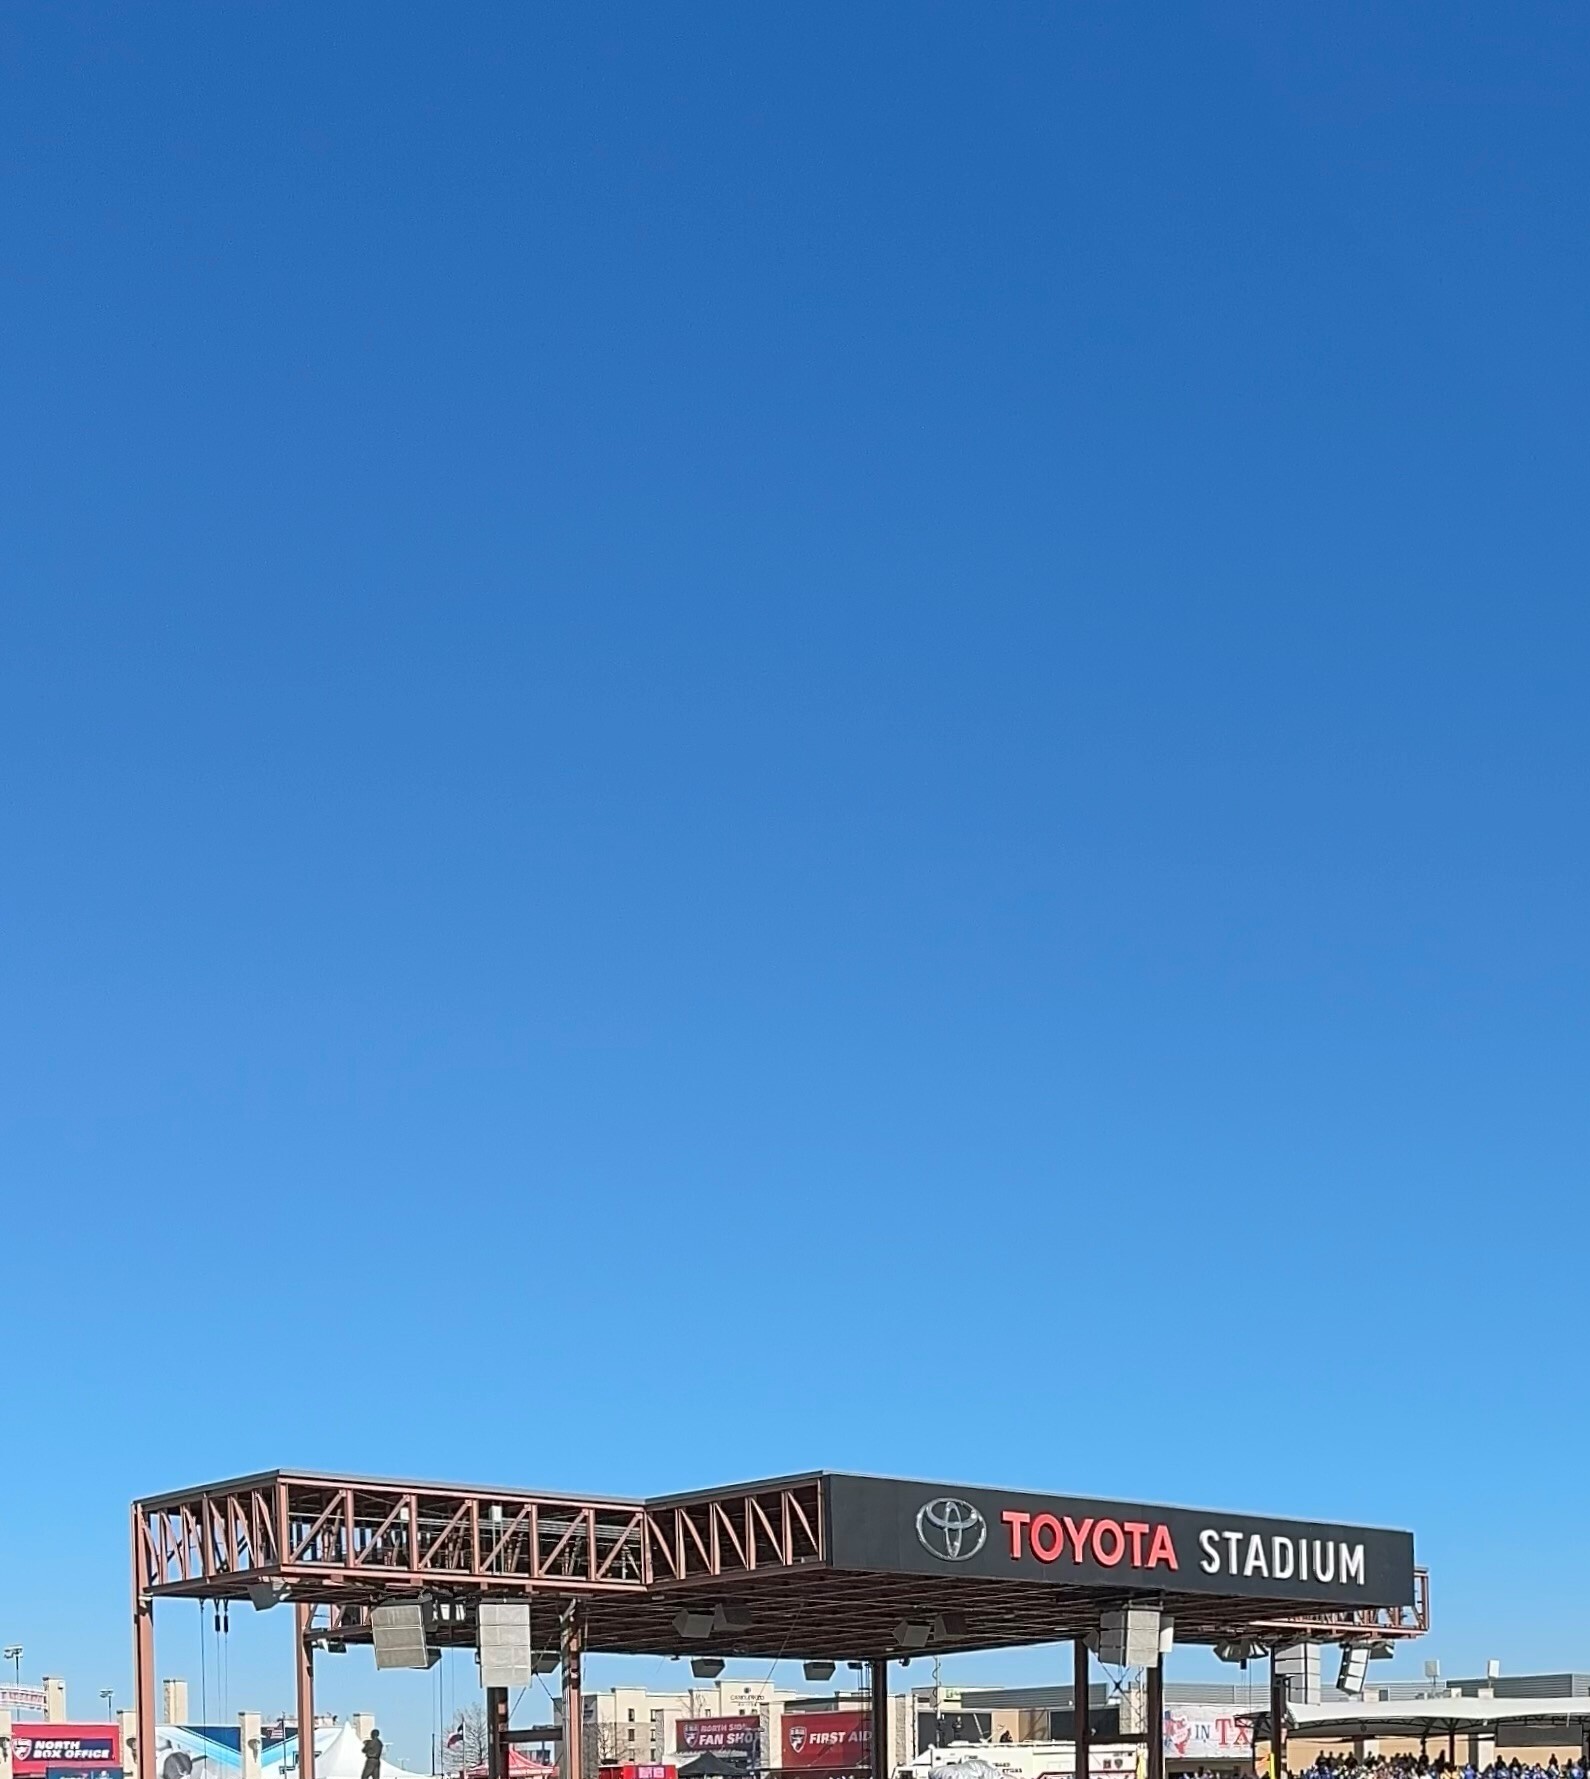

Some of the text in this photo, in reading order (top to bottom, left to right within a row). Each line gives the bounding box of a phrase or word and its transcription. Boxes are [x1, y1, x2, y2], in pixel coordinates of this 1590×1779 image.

[1002, 1510, 1365, 1585] TOYOTA STADIUM
[1195, 1724, 1211, 1739] IN
[699, 1735, 724, 1746] FAN
[809, 1732, 845, 1744] FIRST
[34, 1741, 80, 1750] NORTH
[33, 1750, 110, 1759] BOX OFFICE
